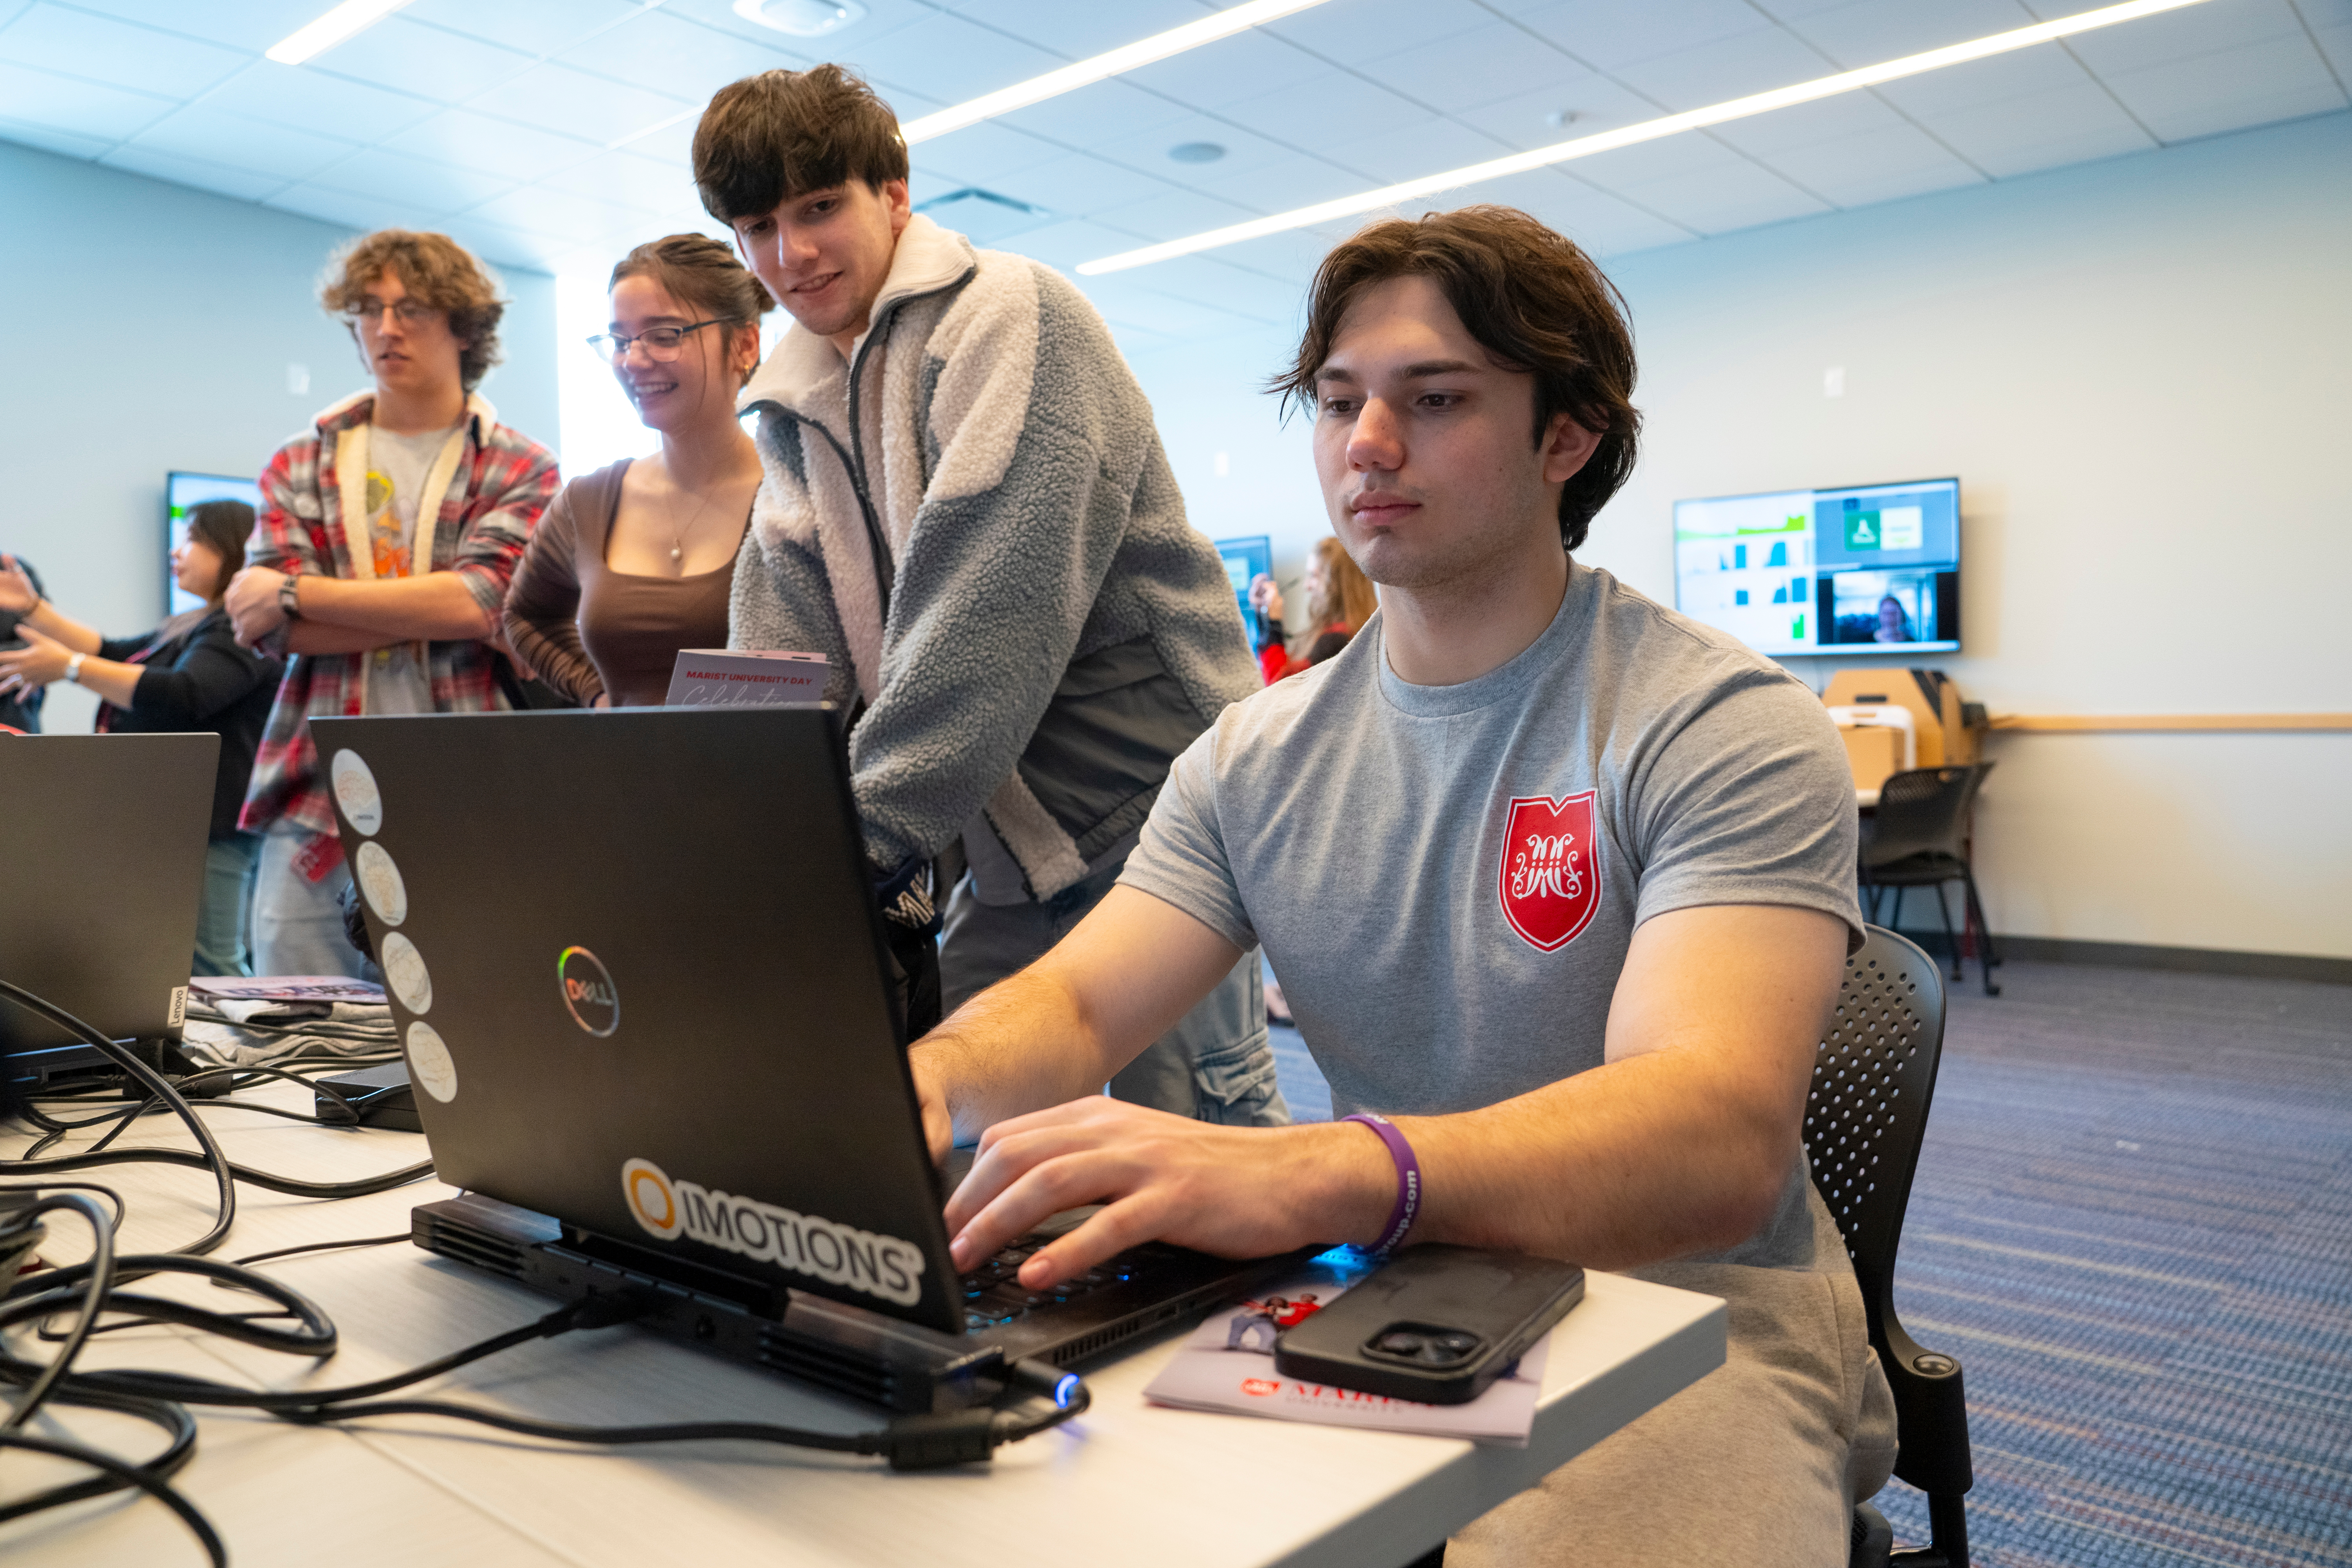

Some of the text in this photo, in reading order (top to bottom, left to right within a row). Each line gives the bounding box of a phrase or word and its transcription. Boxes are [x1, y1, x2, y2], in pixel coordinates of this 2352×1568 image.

[686, 671, 813, 686] MARIST UNIVERSITY DAY
[566, 978, 613, 1006] DELL
[171, 990, 183, 1024] Lenovo
